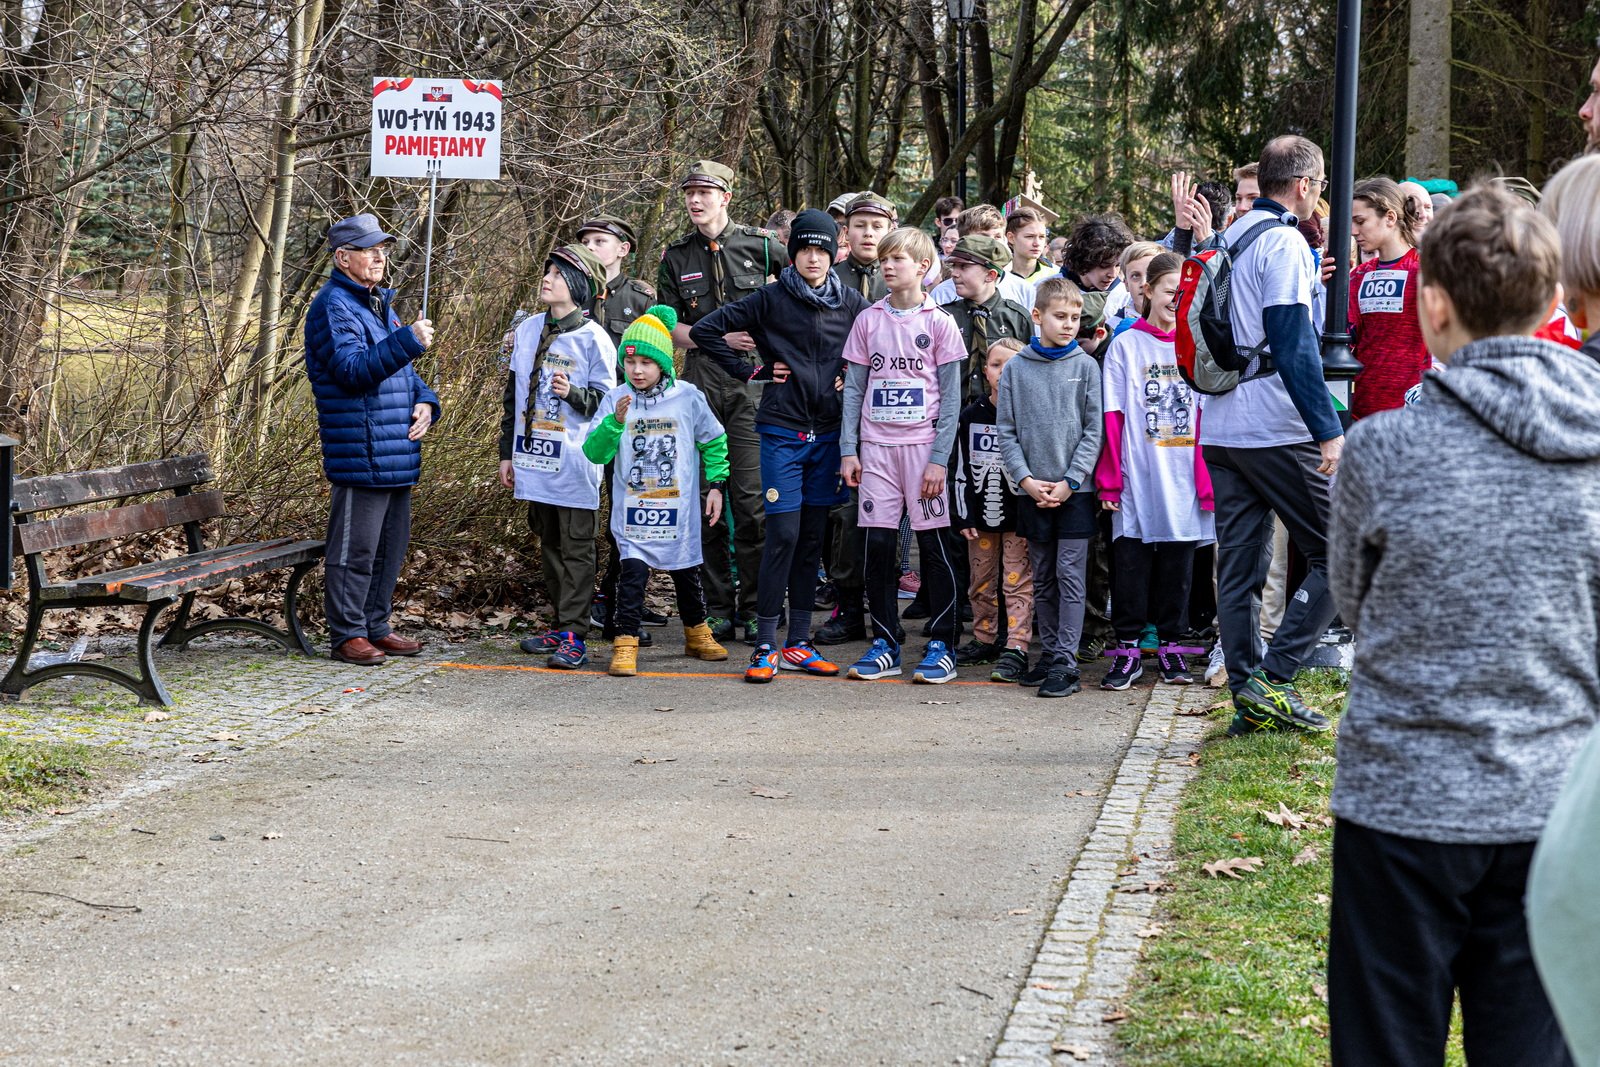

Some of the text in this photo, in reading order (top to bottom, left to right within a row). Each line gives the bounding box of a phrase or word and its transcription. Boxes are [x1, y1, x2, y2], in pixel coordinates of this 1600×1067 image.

[452, 111, 496, 132] 1943
[385, 135, 487, 159] PAMIĘTAMY
[1365, 280, 1397, 297] 060
[889, 357, 924, 371] XBTO
[880, 389, 914, 406] 154
[980, 435, 1001, 452] 05
[917, 495, 945, 521] 10
[634, 509, 671, 526] 092
